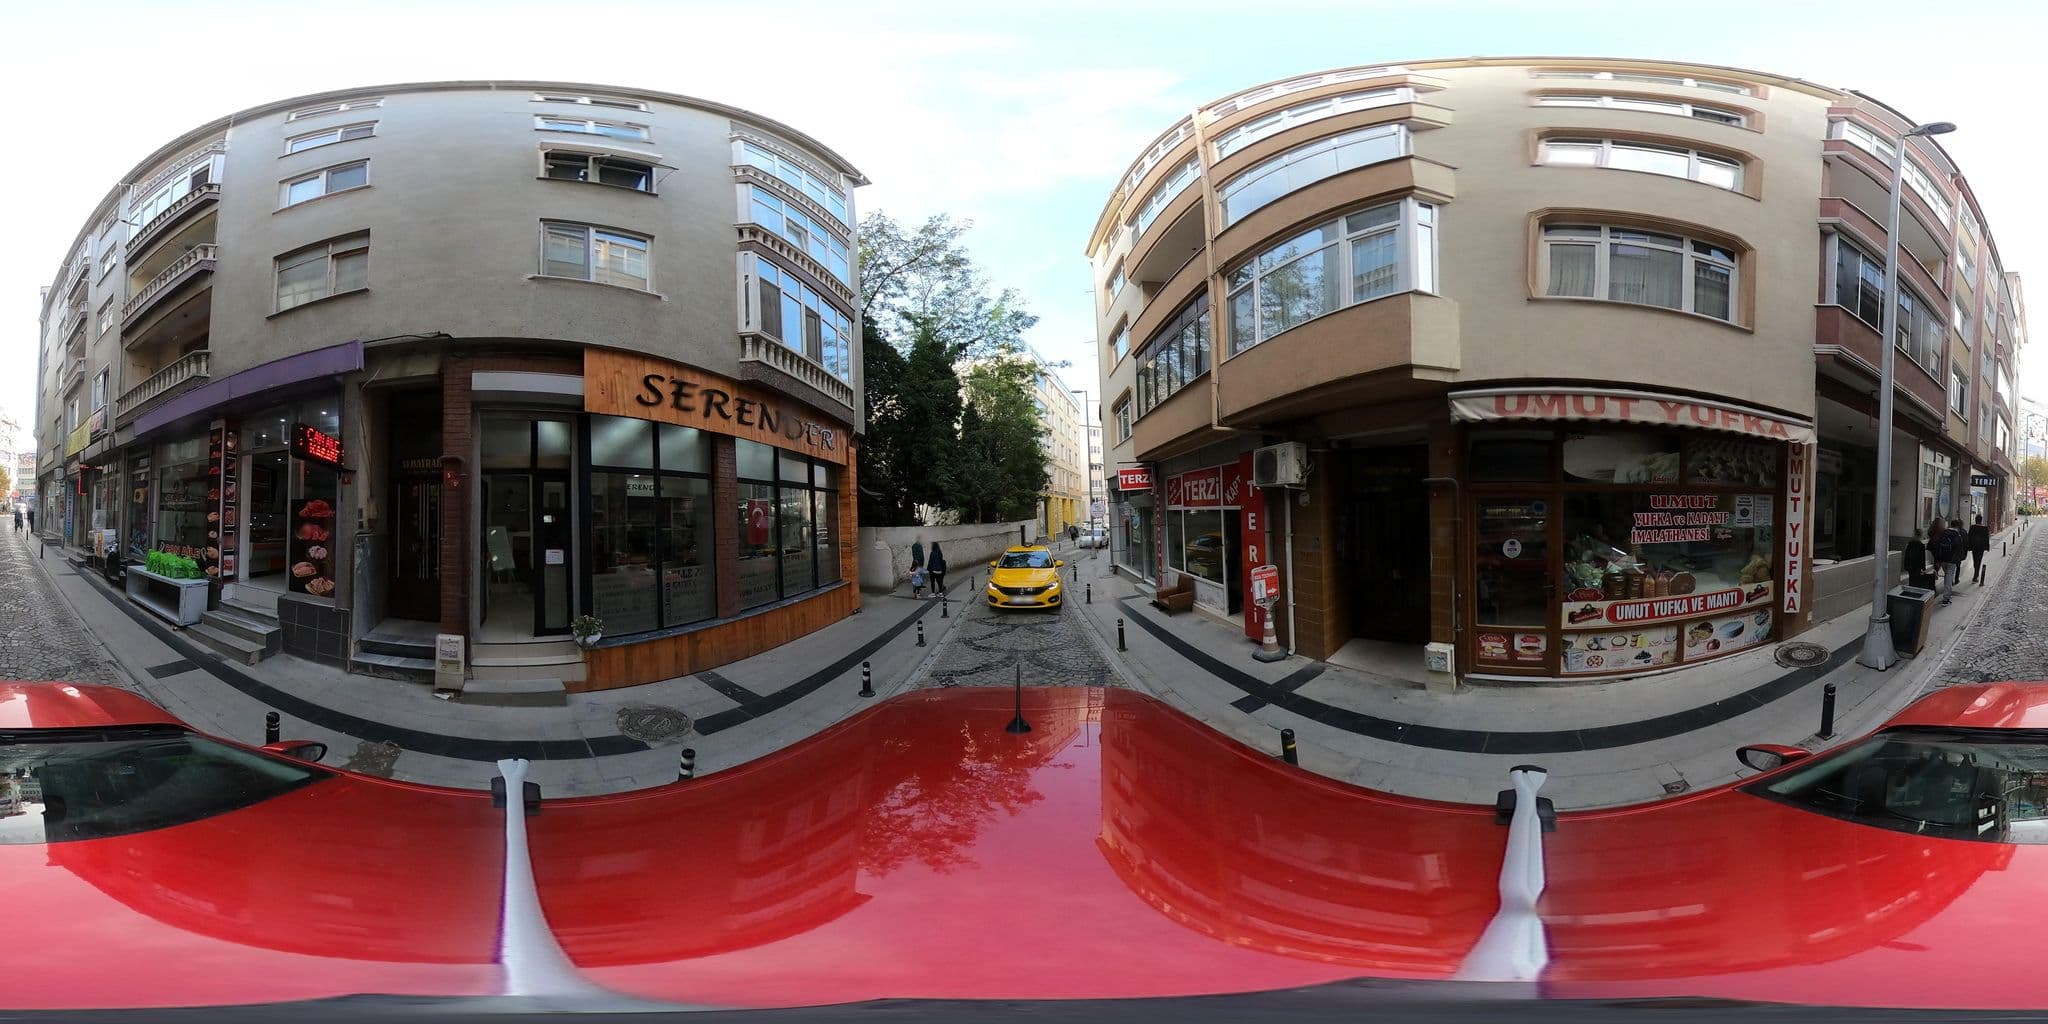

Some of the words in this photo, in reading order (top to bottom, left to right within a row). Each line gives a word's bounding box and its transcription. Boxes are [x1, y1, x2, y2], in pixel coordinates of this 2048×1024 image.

[635, 373, 835, 451] SERENDER
[1493, 394, 1641, 418] UMUT
[1655, 399, 1790, 439] YUFKA
[1790, 442, 1803, 512] UMUT
[1634, 512, 1674, 527] YUFKA
[1673, 515, 1686, 526] ve
[1650, 495, 1717, 509] UMUT
[1786, 522, 1800, 611] YUFKA
[1616, 604, 1650, 621] UMUT
[1653, 598, 1688, 616] YUFKA
[1692, 597, 1704, 611] VE
[1707, 591, 1738, 607] MANTI
